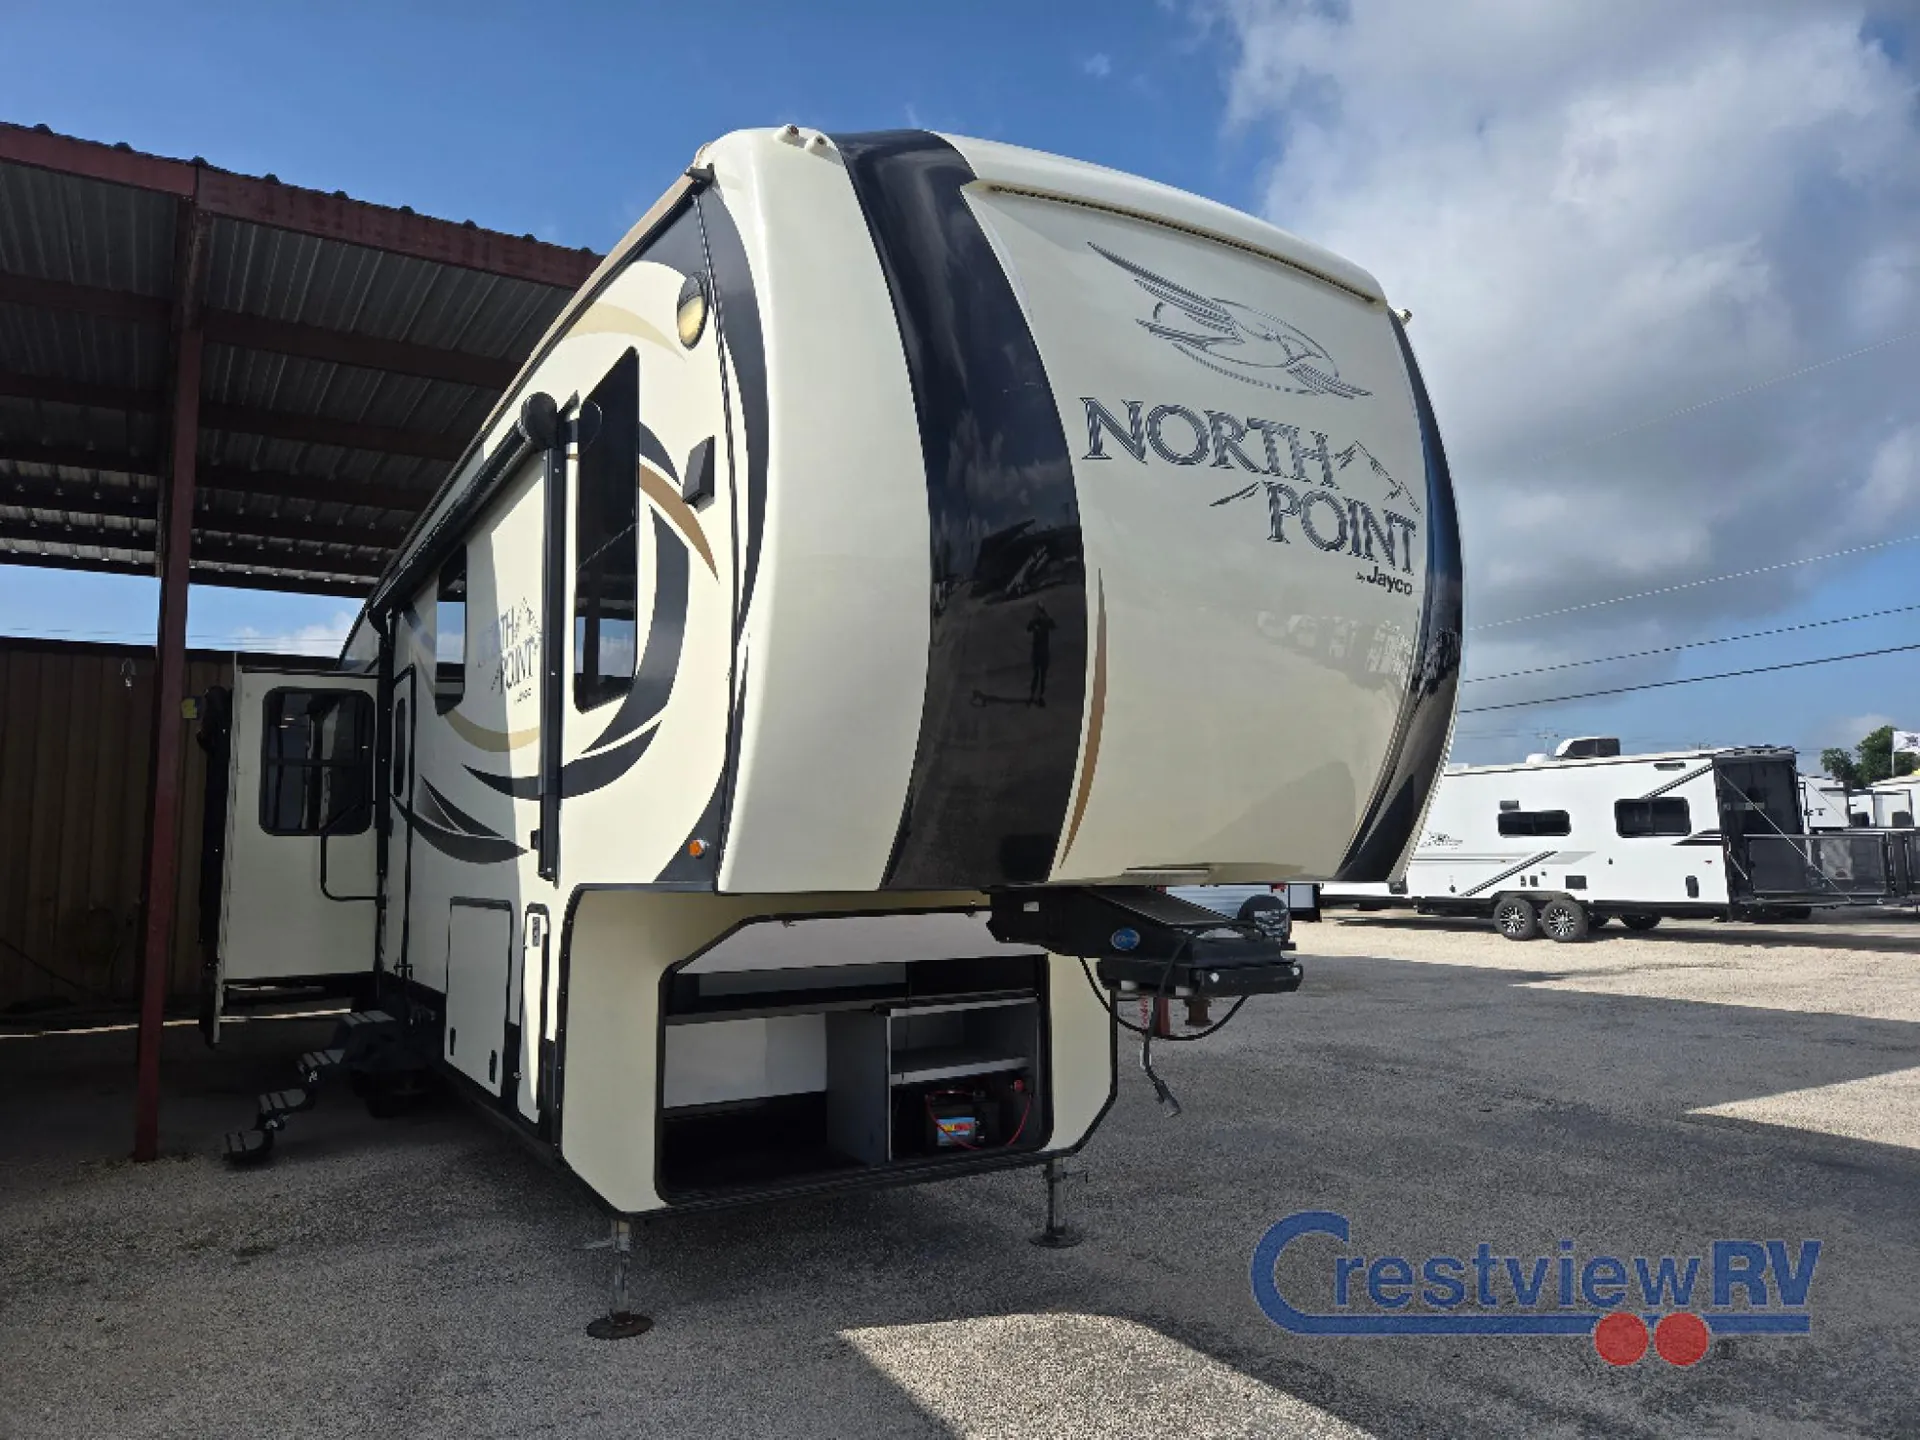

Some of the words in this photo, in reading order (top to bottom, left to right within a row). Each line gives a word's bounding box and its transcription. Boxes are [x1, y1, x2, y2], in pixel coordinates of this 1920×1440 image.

[1079, 397, 1340, 490] NORTH
[1261, 480, 1417, 576] POINT
[1366, 565, 1413, 596] Jayco
